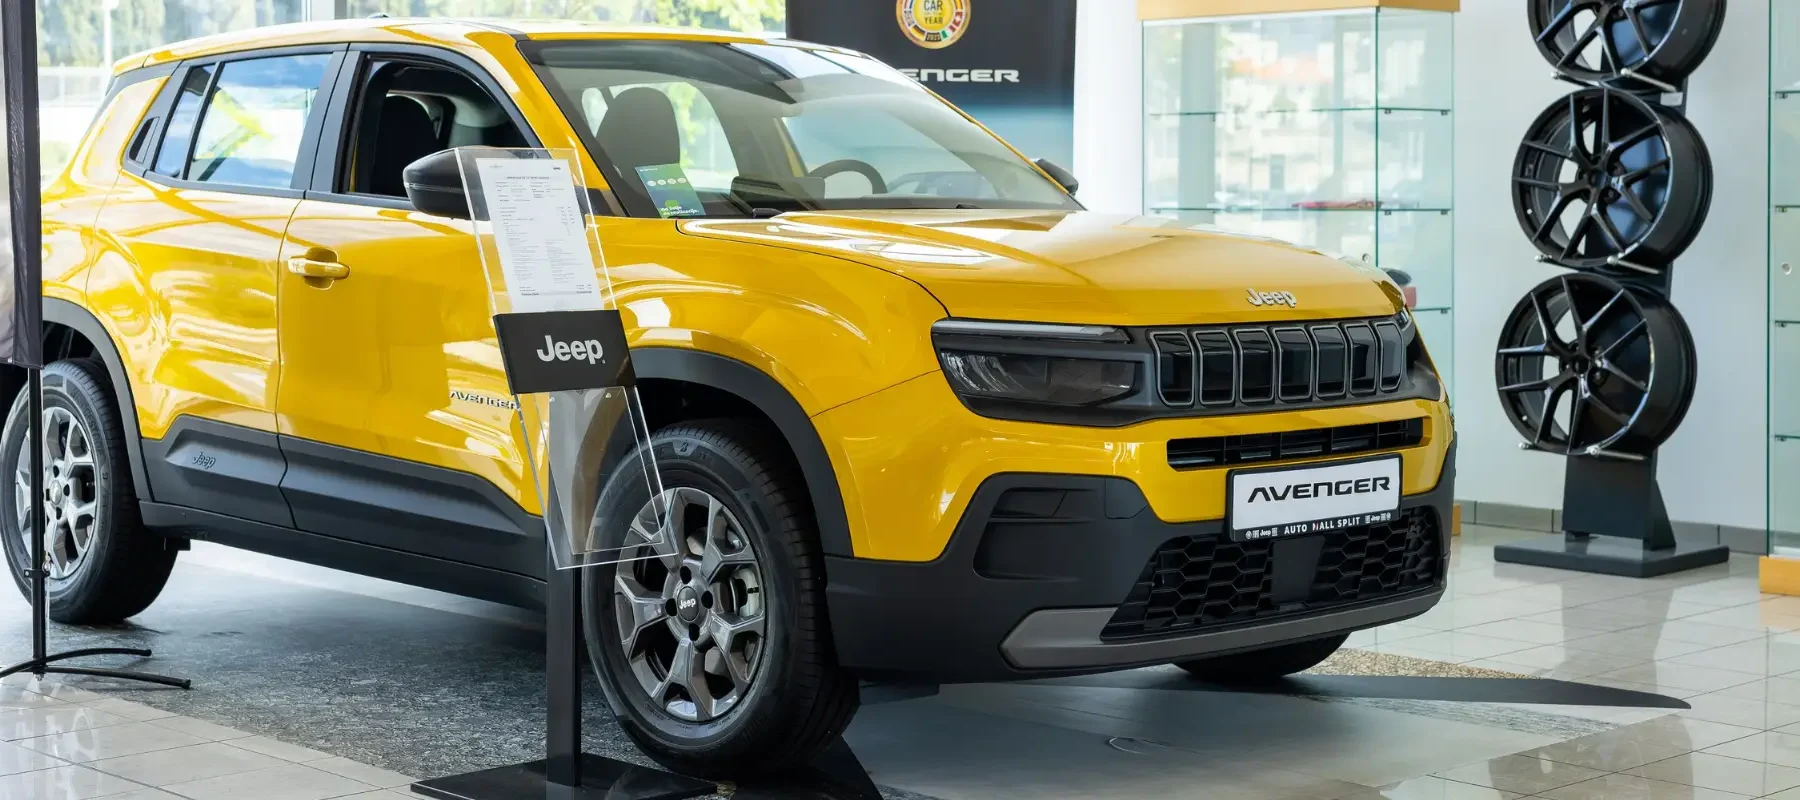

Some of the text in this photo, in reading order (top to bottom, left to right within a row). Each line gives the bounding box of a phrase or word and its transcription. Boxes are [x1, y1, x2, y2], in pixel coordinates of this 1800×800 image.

[924, 0, 943, 11] CAR
[1246, 288, 1297, 308] Jeep
[536, 335, 605, 364] Jeep
[192, 451, 217, 470] Jeep
[1248, 477, 1390, 503] AVENGER
[1284, 523, 1308, 535] AUTO
[1312, 520, 1335, 531] MALL
[1337, 516, 1360, 528] SPLIT
[680, 598, 696, 610] Jeep
